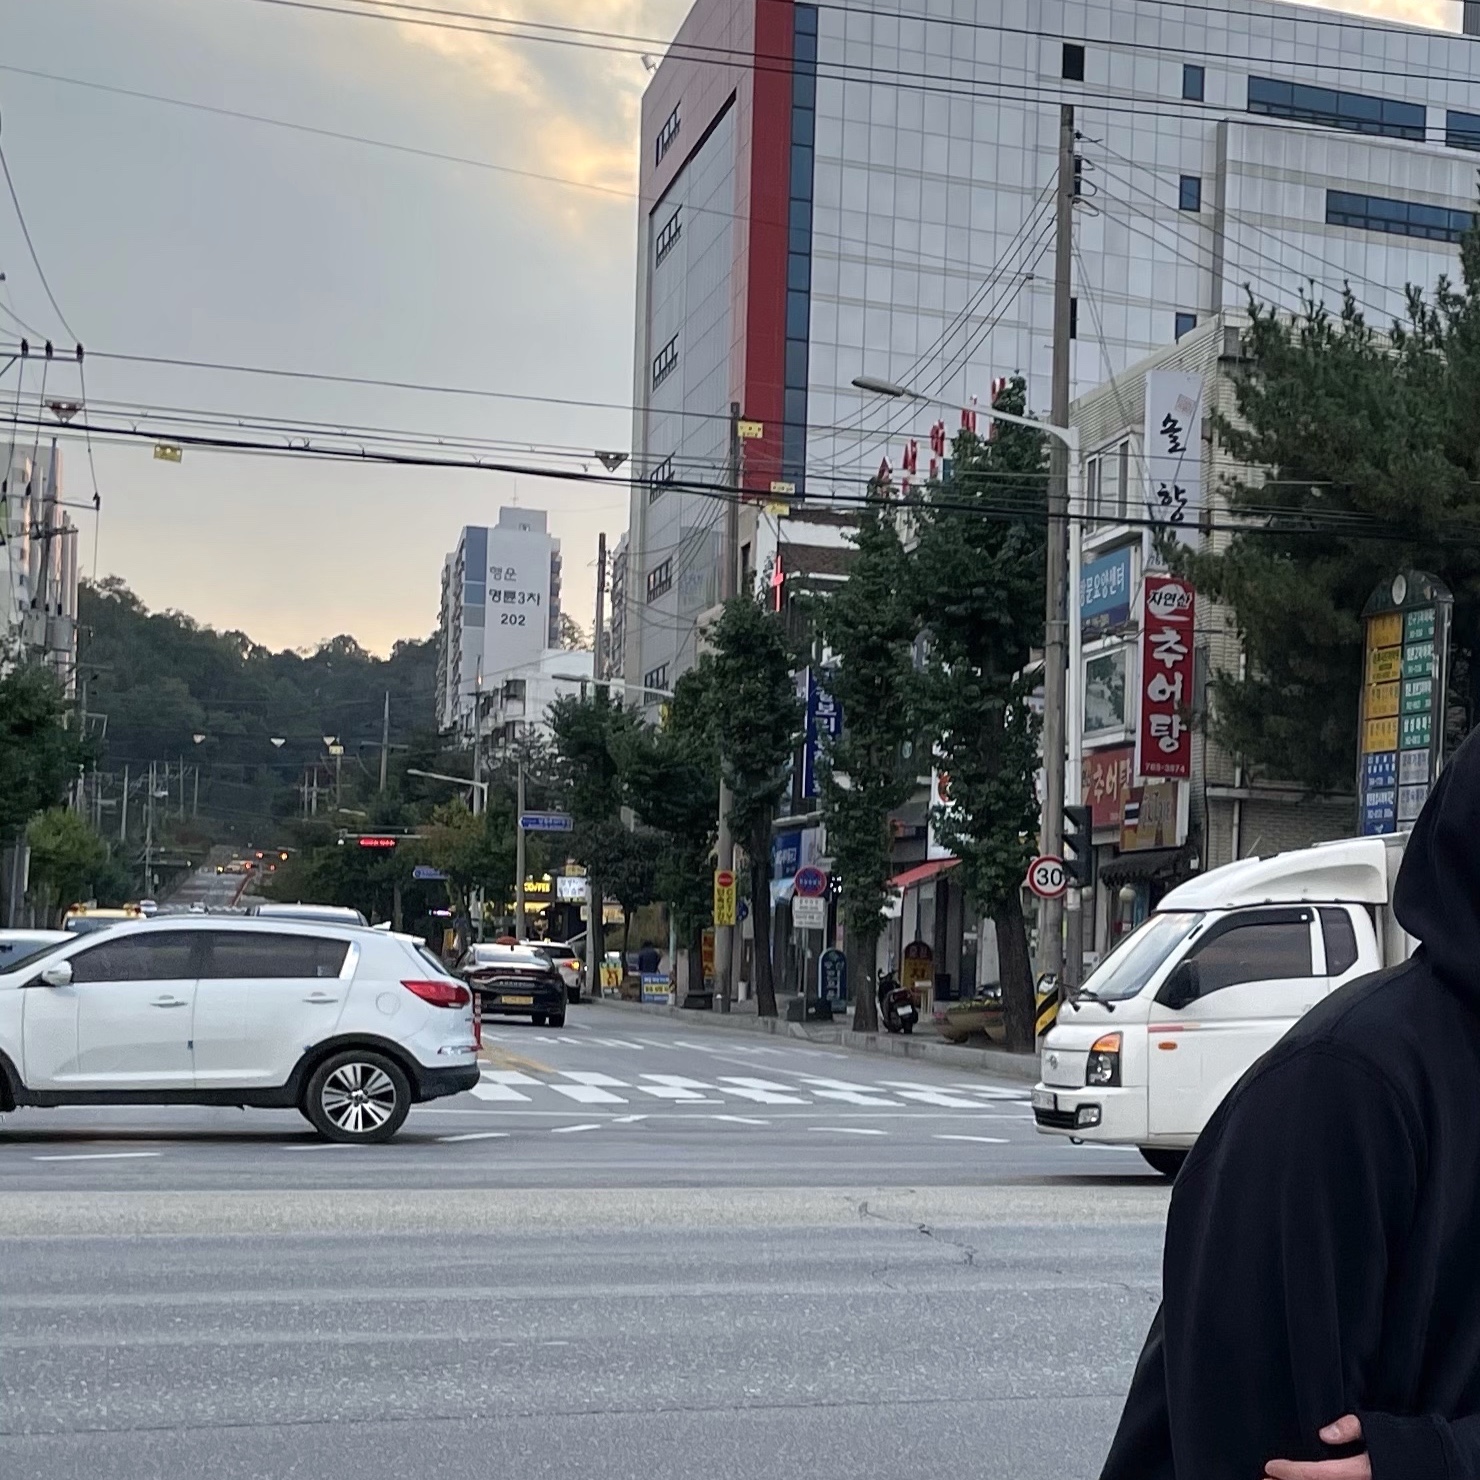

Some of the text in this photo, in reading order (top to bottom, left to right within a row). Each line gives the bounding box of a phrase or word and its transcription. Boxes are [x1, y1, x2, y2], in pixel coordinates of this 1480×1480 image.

[1149, 590, 1191, 608] 자연산
[500, 613, 526, 626] 202
[1147, 626, 1189, 753] 추어탕
[1036, 867, 1063, 887] 30
